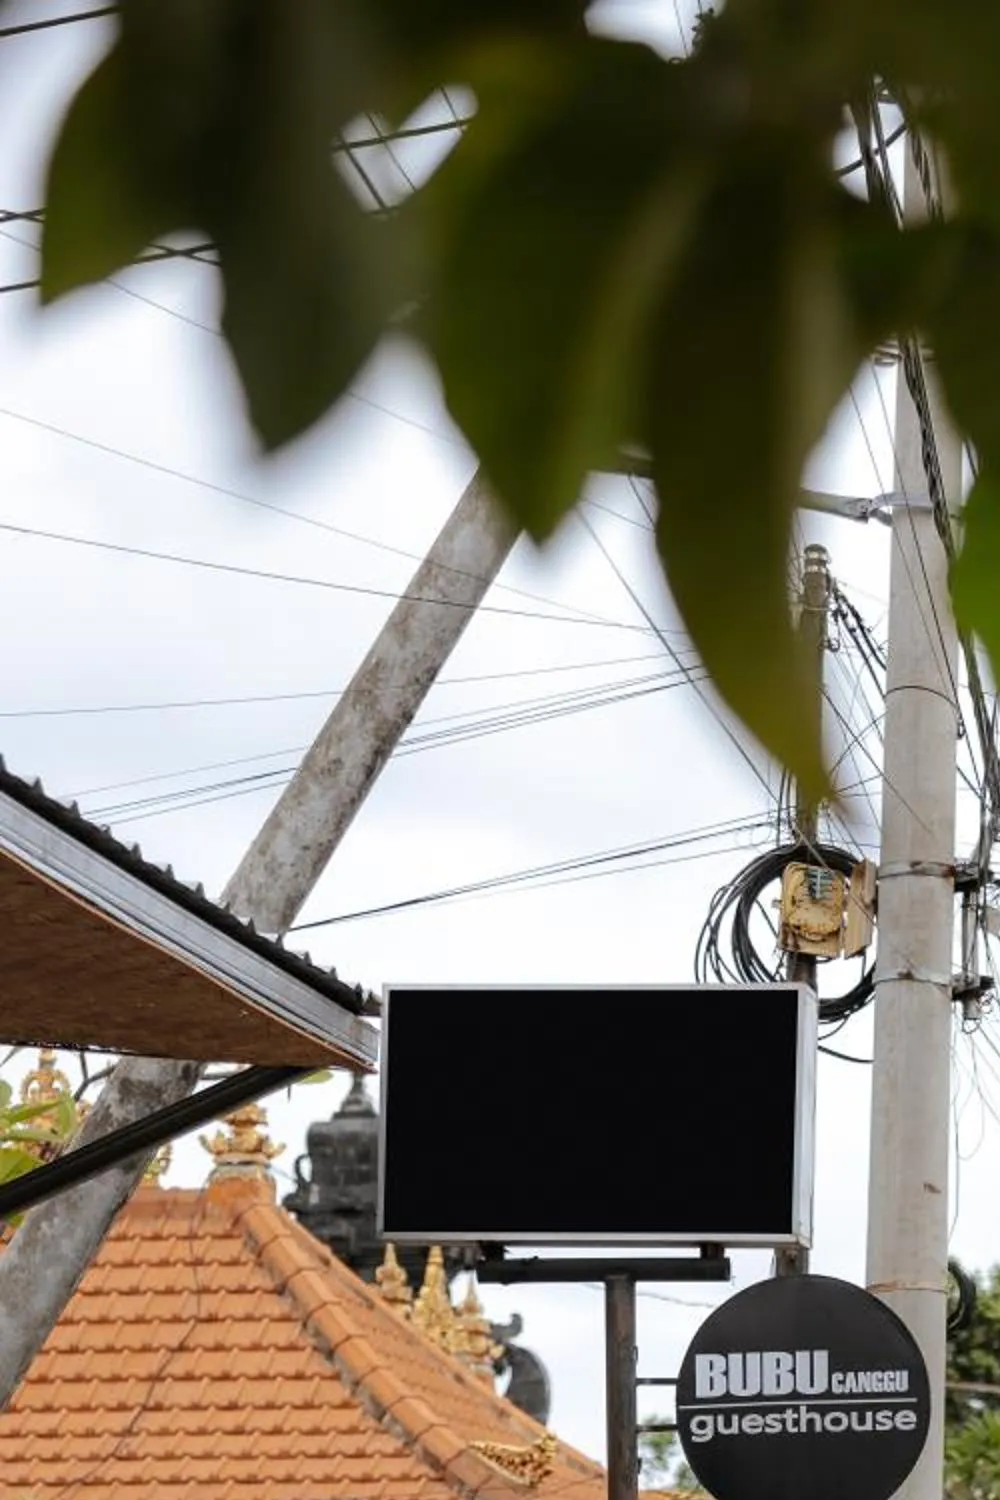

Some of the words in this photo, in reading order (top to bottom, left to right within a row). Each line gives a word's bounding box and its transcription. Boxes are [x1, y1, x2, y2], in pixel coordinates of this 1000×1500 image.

[695, 1350, 829, 1399] BUBU
[831, 1370, 909, 1394] CANGGU
[690, 1405, 917, 1443] guesthouse
